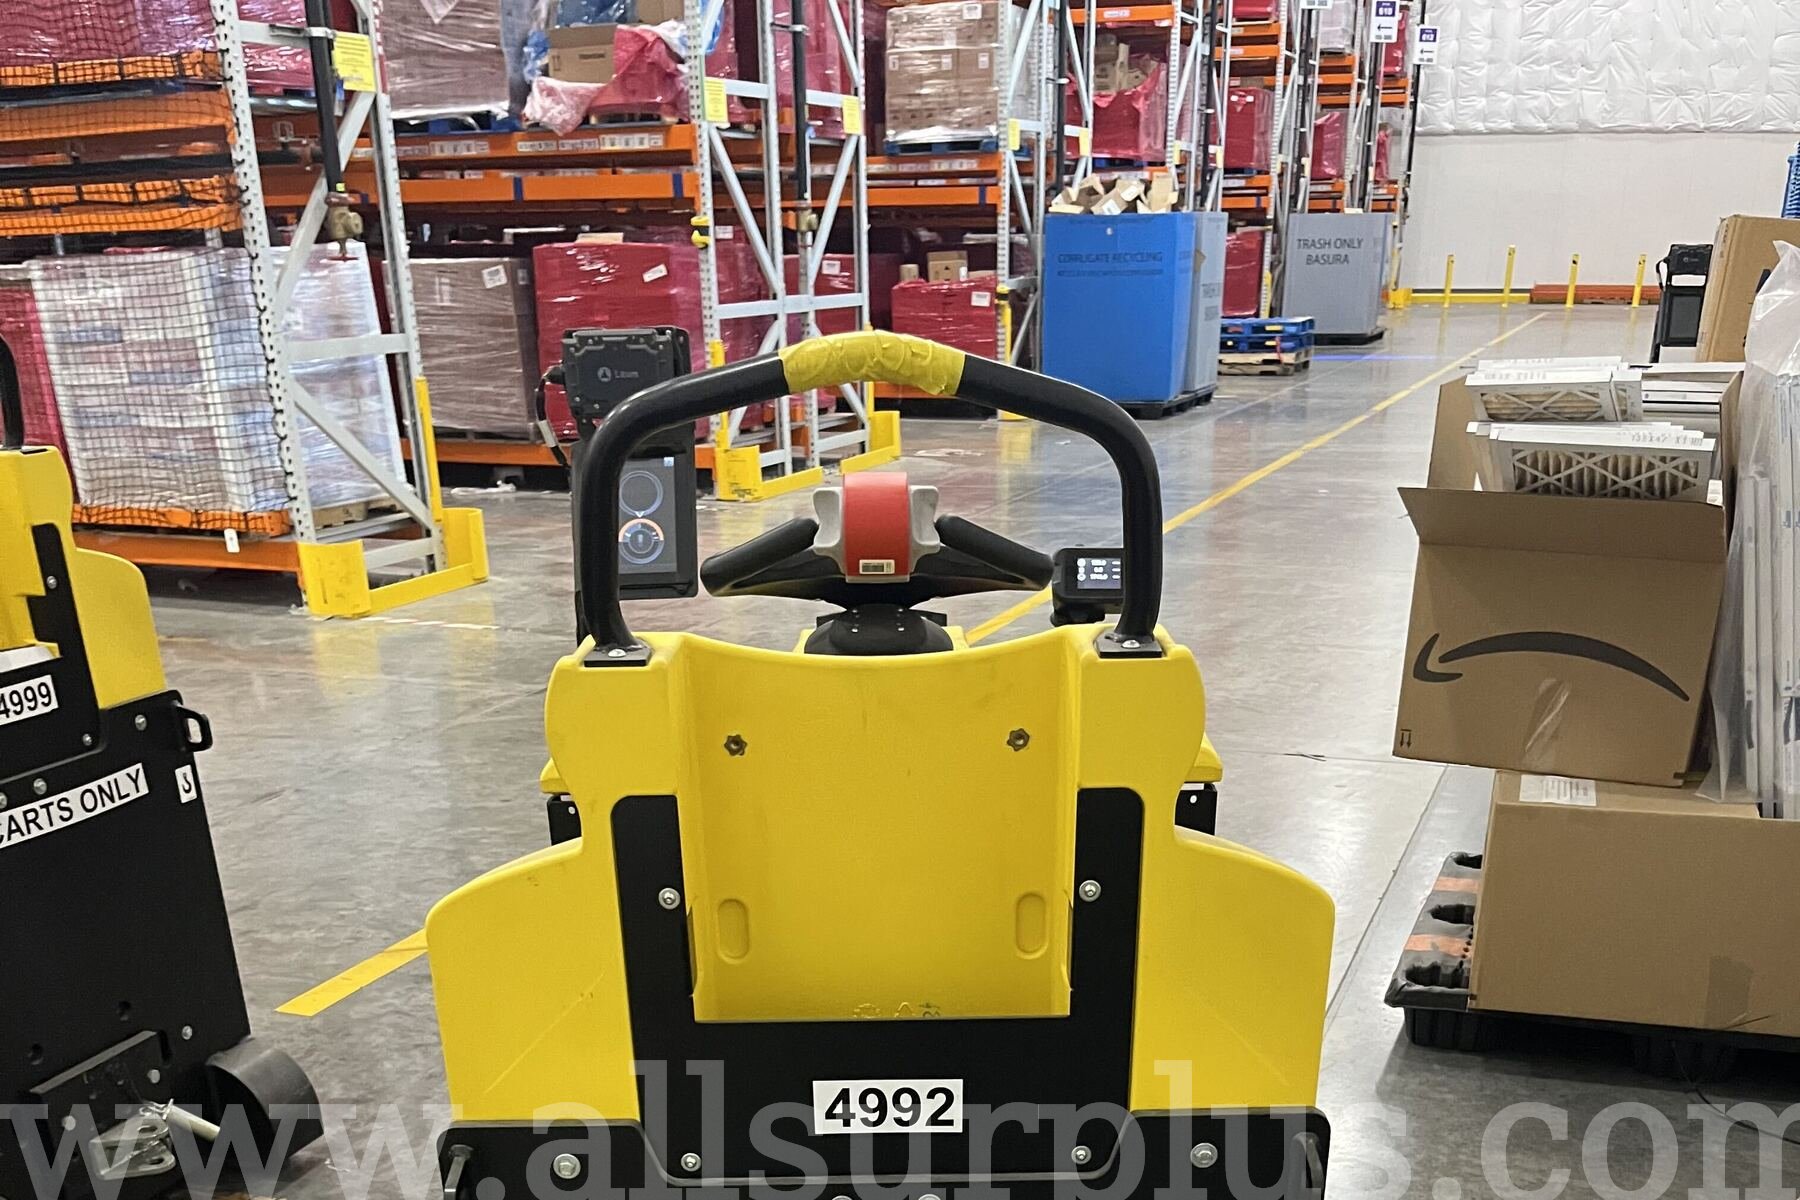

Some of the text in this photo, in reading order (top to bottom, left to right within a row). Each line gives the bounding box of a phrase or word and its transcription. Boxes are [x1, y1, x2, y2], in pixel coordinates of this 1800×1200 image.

[1297, 238, 1363, 249] TRASH ONLY
[1306, 254, 1350, 265] BASURA
[80, 768, 141, 813] ONLY
[825, 1087, 955, 1127] 4992
